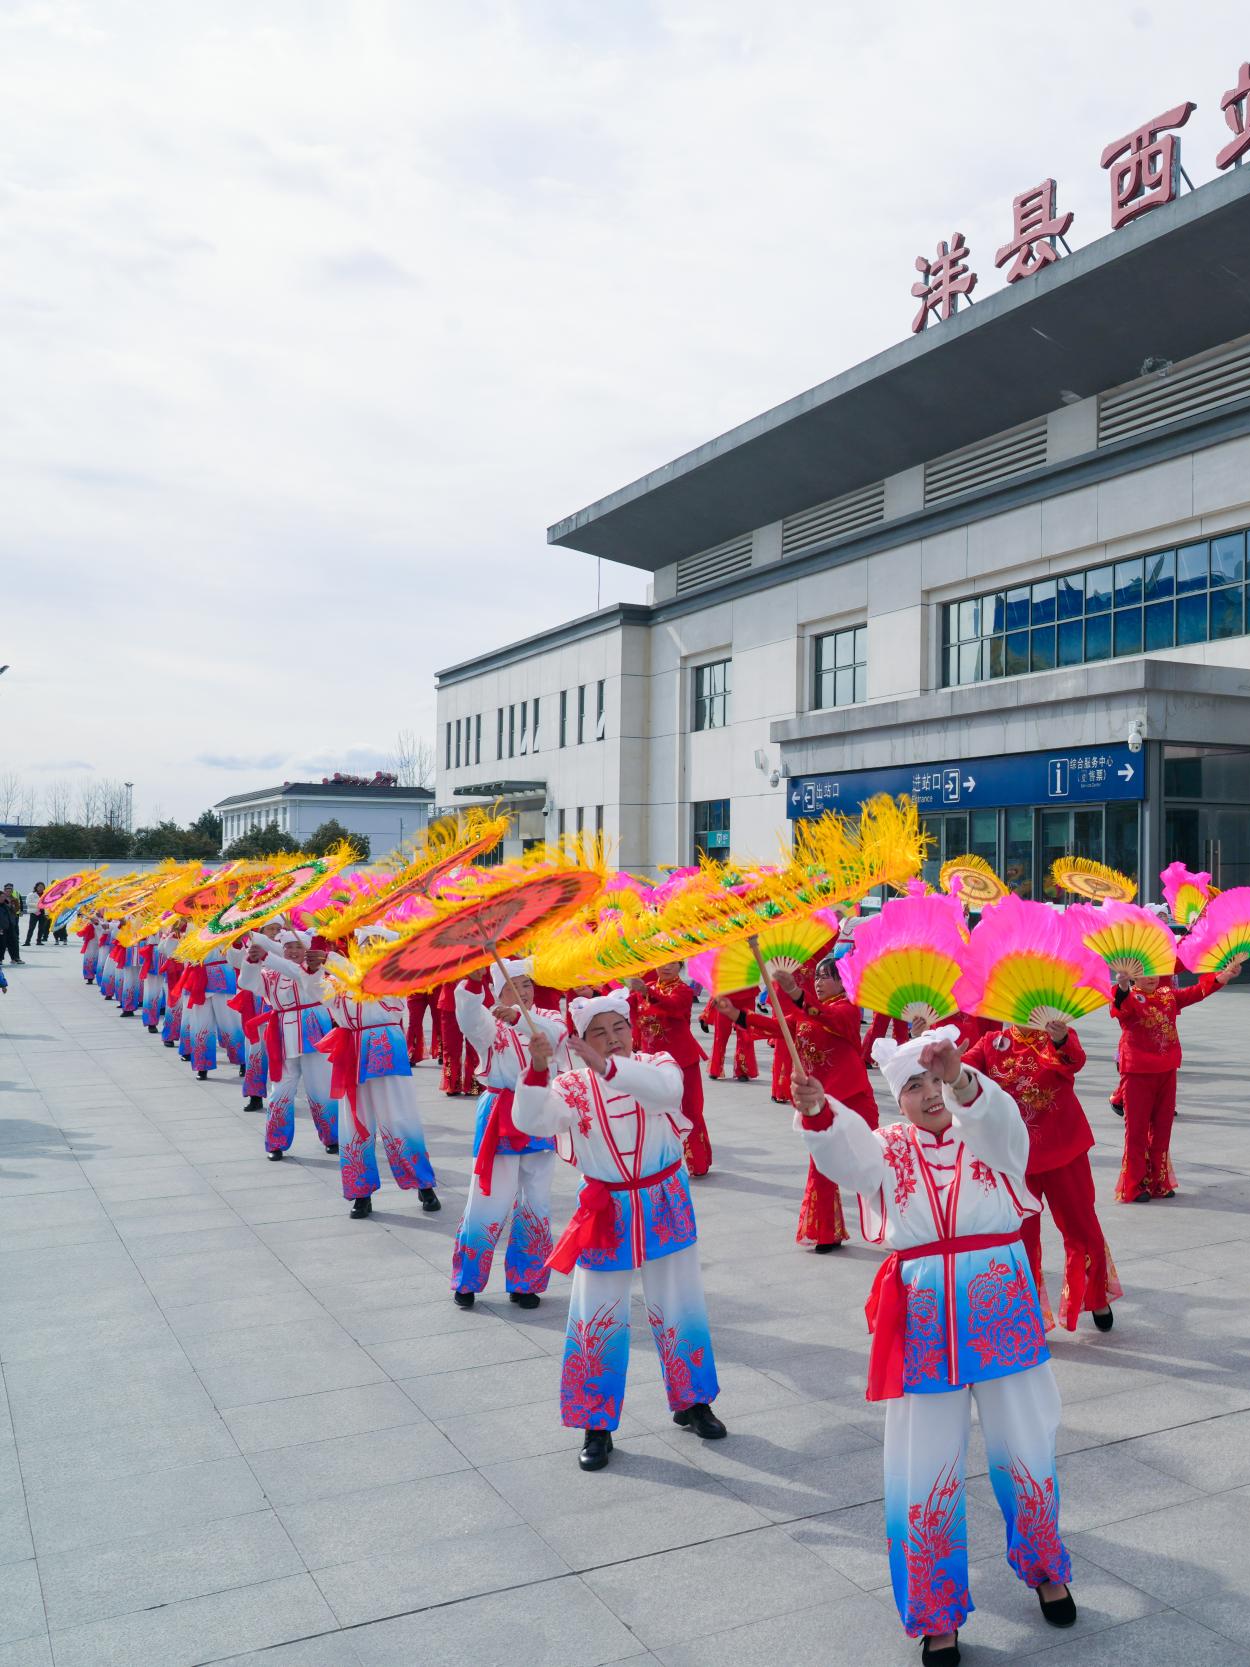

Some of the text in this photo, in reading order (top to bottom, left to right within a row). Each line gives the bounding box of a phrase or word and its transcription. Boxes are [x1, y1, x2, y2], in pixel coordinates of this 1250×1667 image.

[1069, 755, 1114, 769] 综合服务中心
[816, 782, 839, 799] 出站口
[912, 773, 941, 792] 进站口
